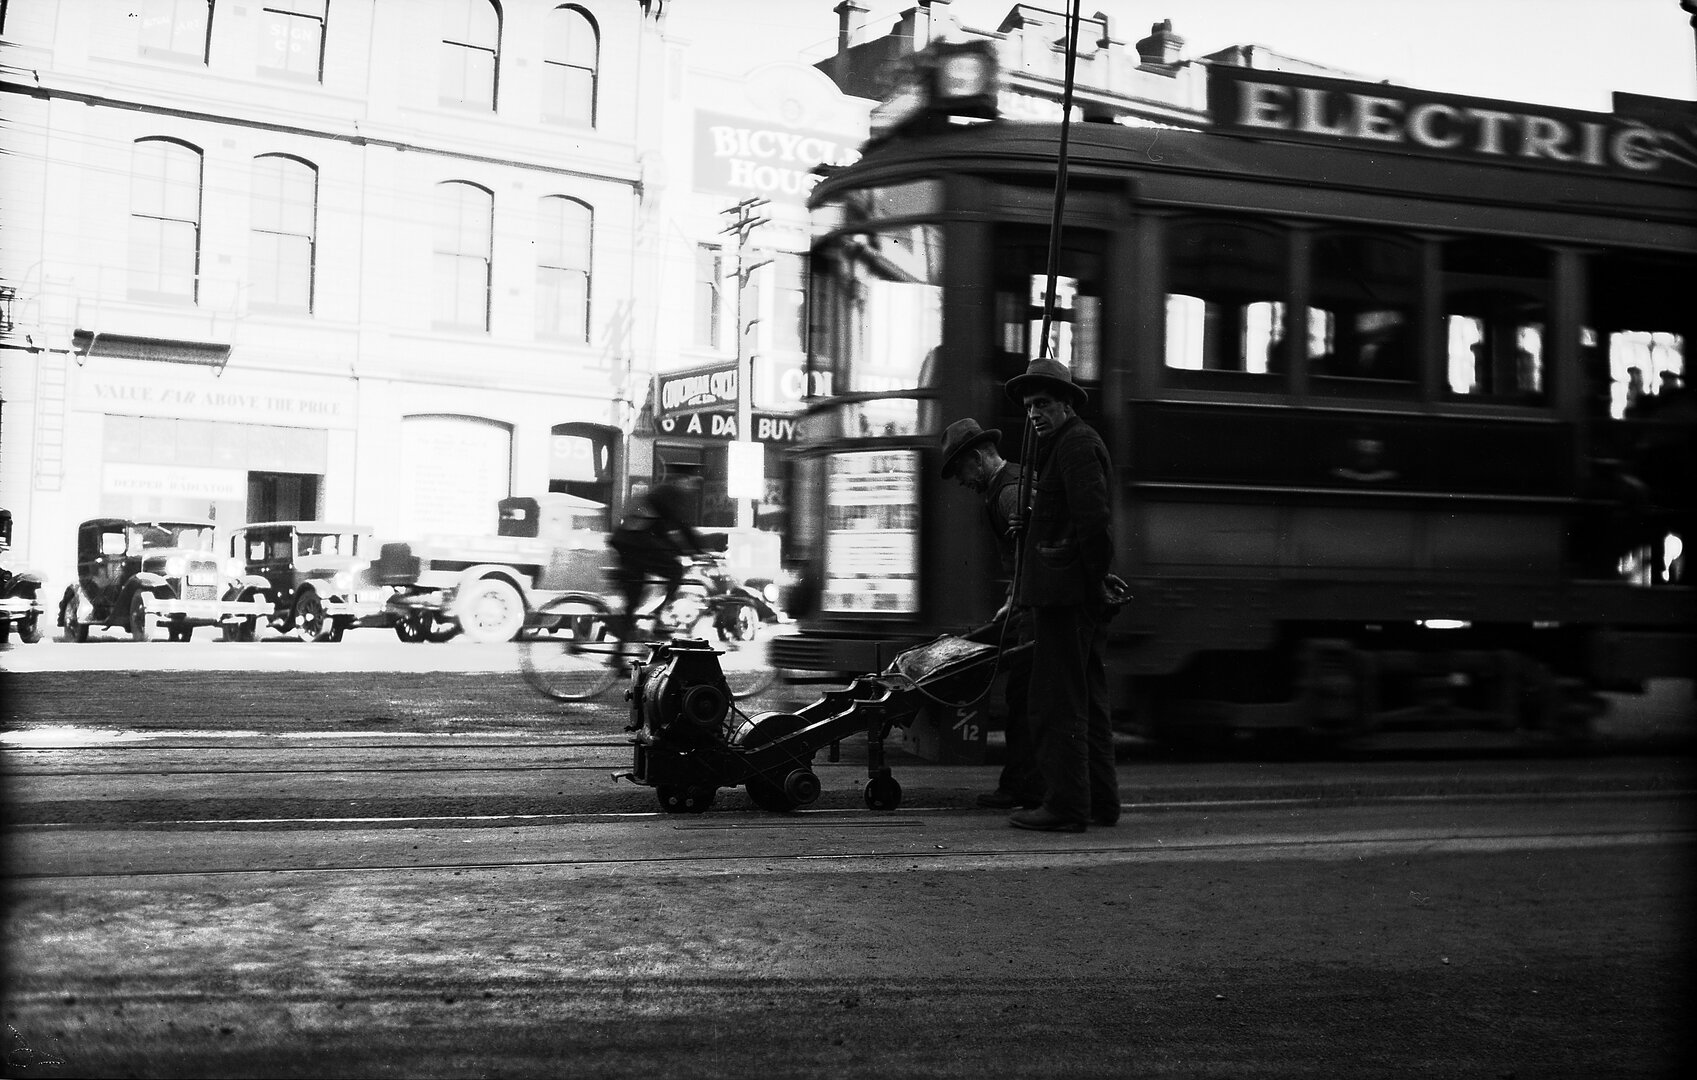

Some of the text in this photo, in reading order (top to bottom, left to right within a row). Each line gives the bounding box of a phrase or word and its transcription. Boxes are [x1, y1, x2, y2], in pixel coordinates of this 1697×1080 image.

[270, 23, 312, 41] SIGN
[1234, 79, 1662, 170] ELECTRIC
[728, 157, 824, 195] HOUS
[93, 383, 341, 416] VALUE FAR ABOVE THE PRICE
[686, 412, 703, 434] A
[711, 414, 737, 437] DA
[553, 437, 590, 460] 95
[113, 478, 234, 494] DEEPER RADIATOR
